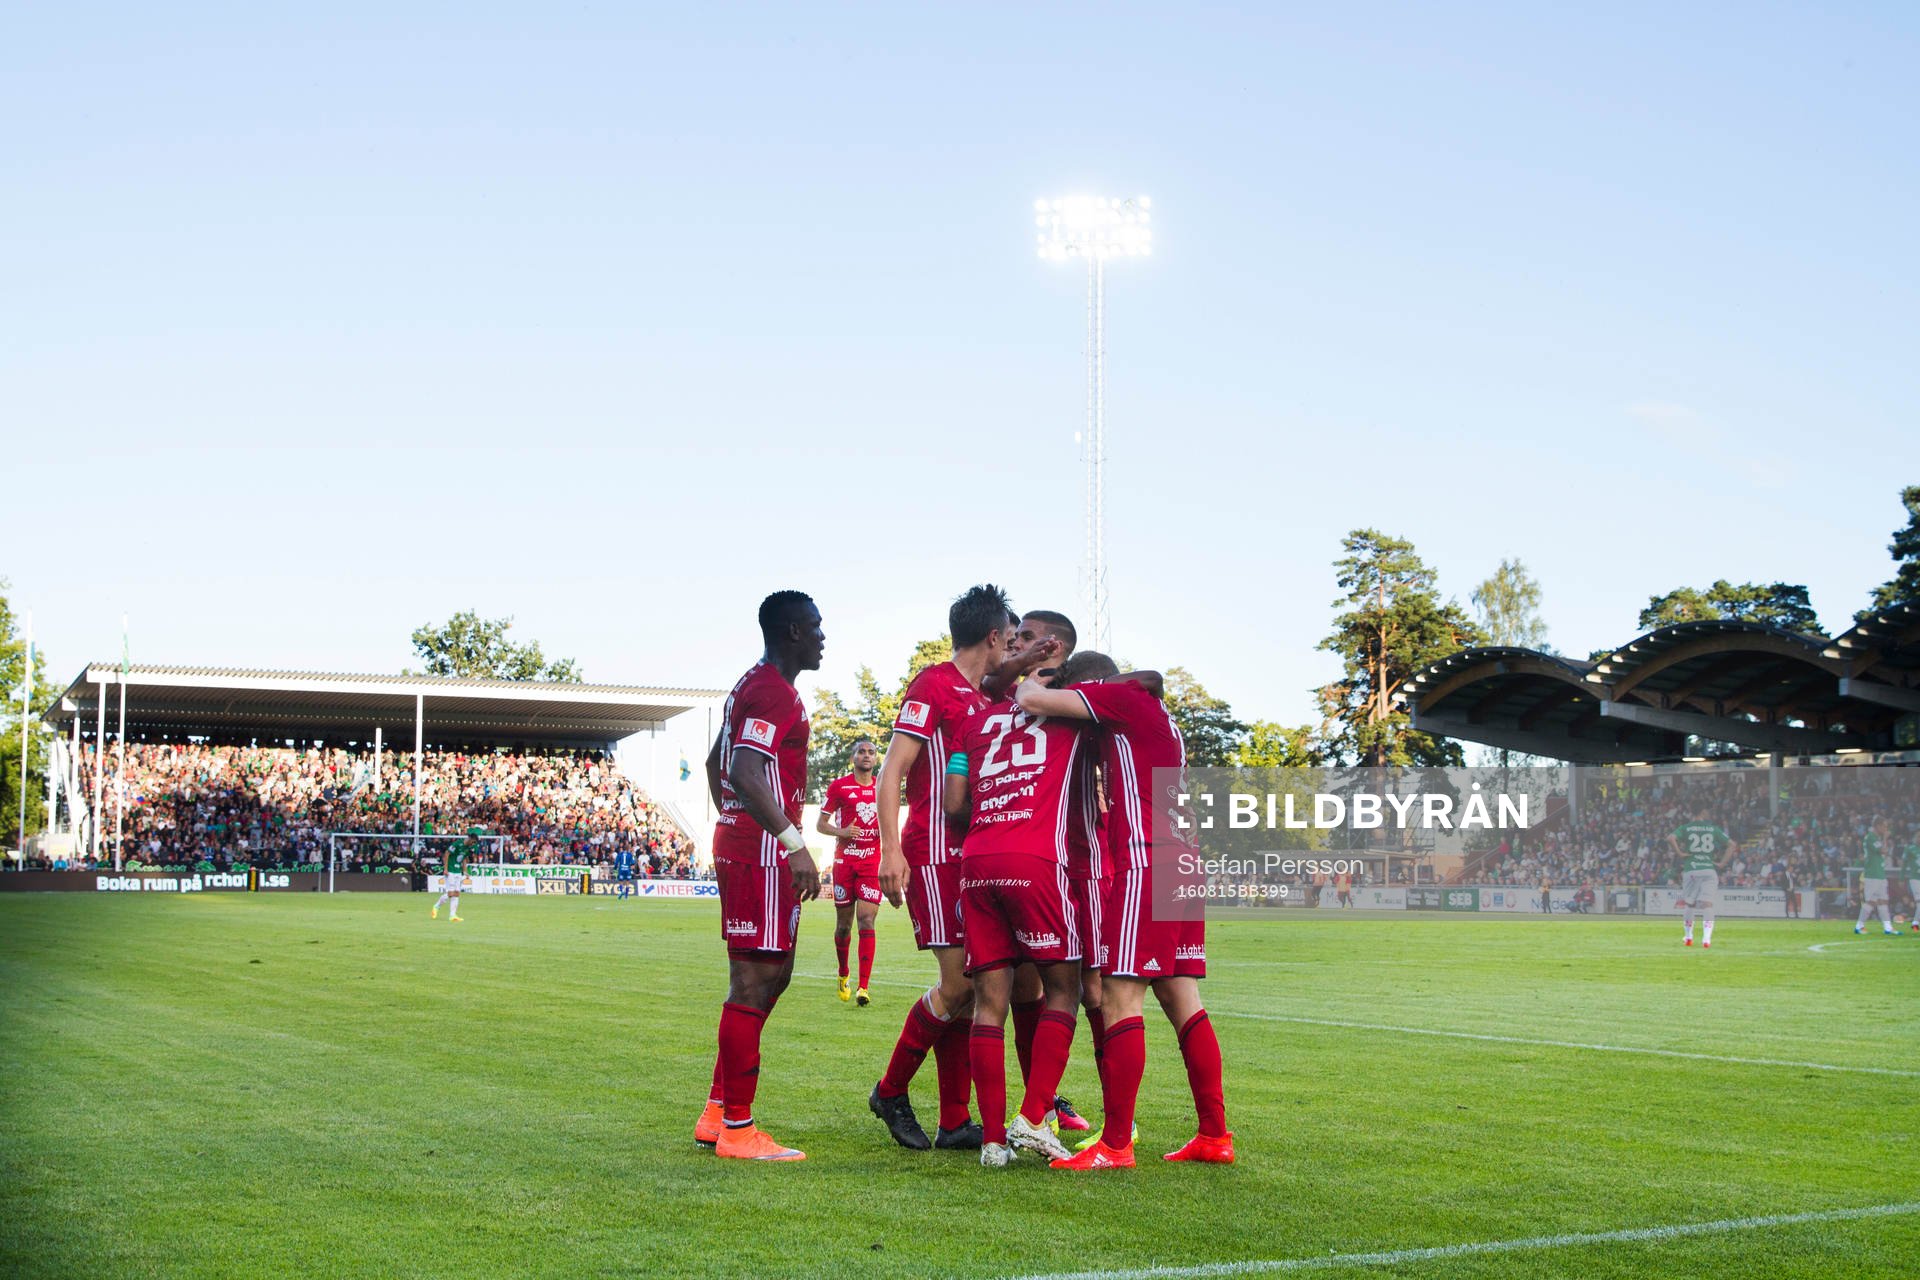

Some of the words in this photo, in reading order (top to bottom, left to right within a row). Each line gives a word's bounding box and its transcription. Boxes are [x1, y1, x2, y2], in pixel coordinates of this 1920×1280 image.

[979, 713, 1047, 778] 23
[1688, 833, 1715, 853] 28
[96, 876, 141, 891] Boka
[143, 877, 178, 891] rum
[180, 874, 203, 893] på
[204, 872, 290, 887] rchotl.se
[1448, 891, 1472, 907] SEB
